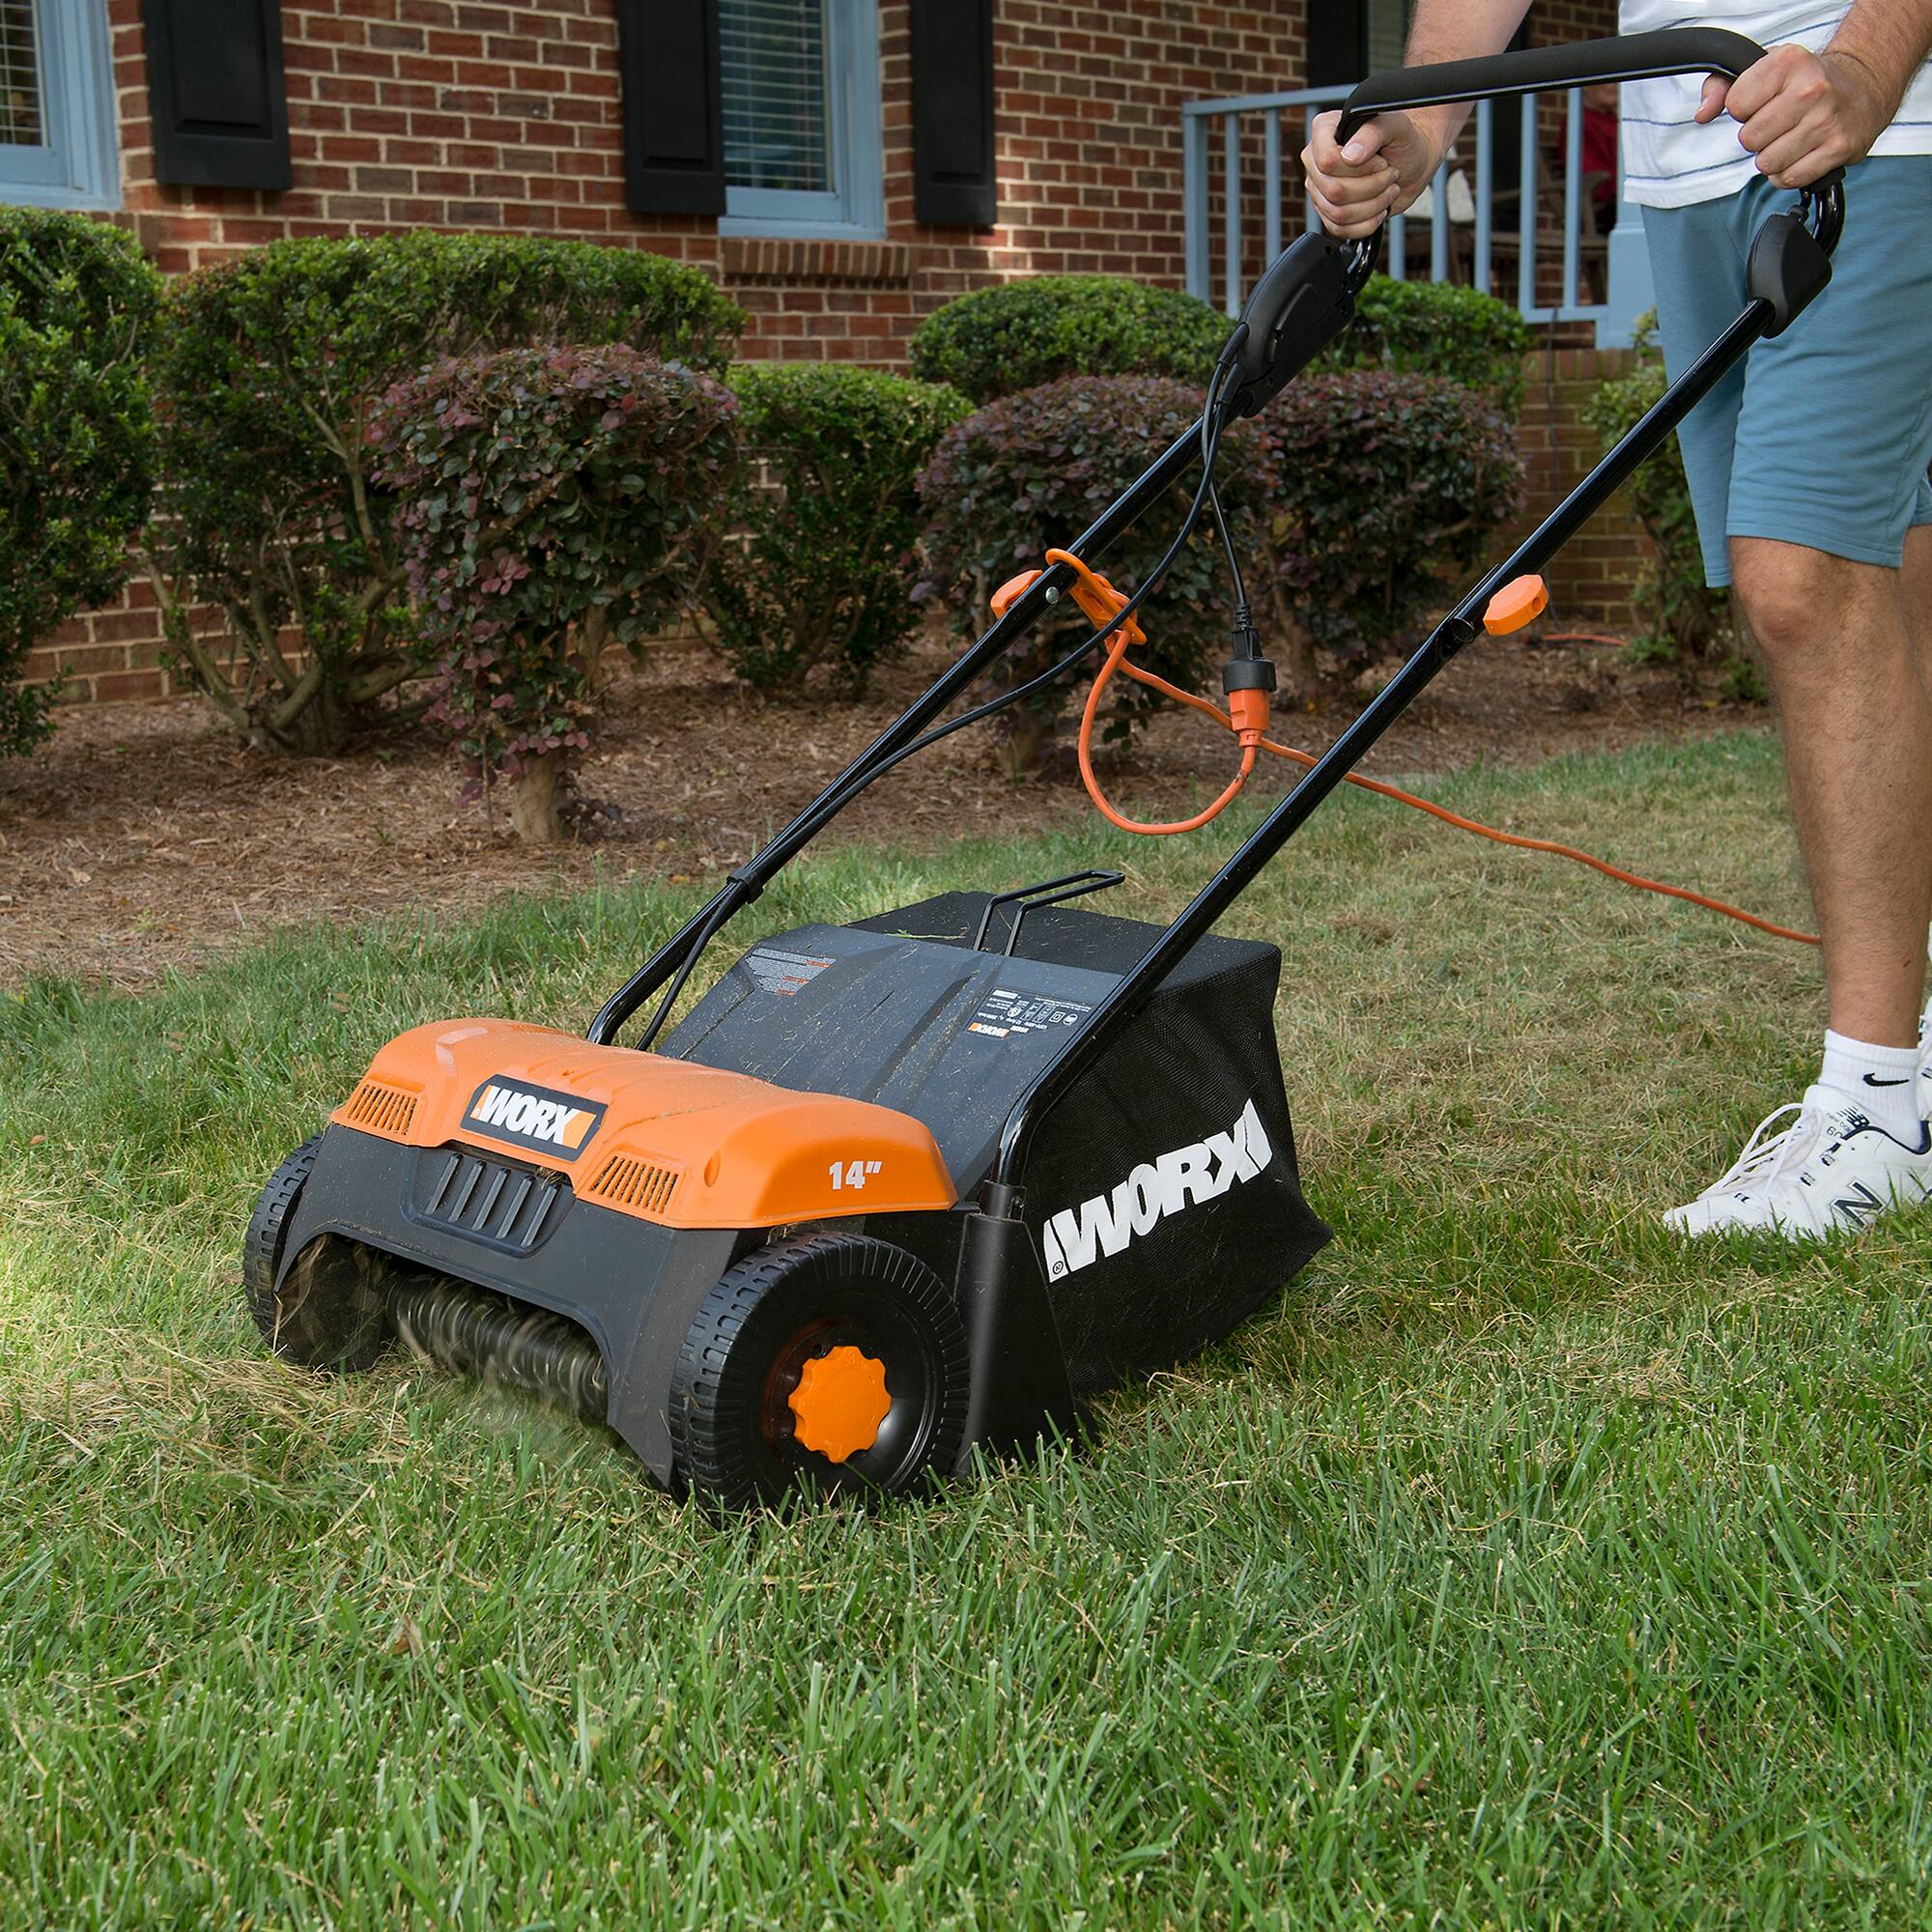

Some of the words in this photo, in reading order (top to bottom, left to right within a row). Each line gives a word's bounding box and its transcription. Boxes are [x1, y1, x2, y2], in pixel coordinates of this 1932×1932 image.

[478, 1085, 582, 1146] WORX
[829, 1161, 882, 1190] 14"
[1049, 1106, 1265, 1273] WORX
